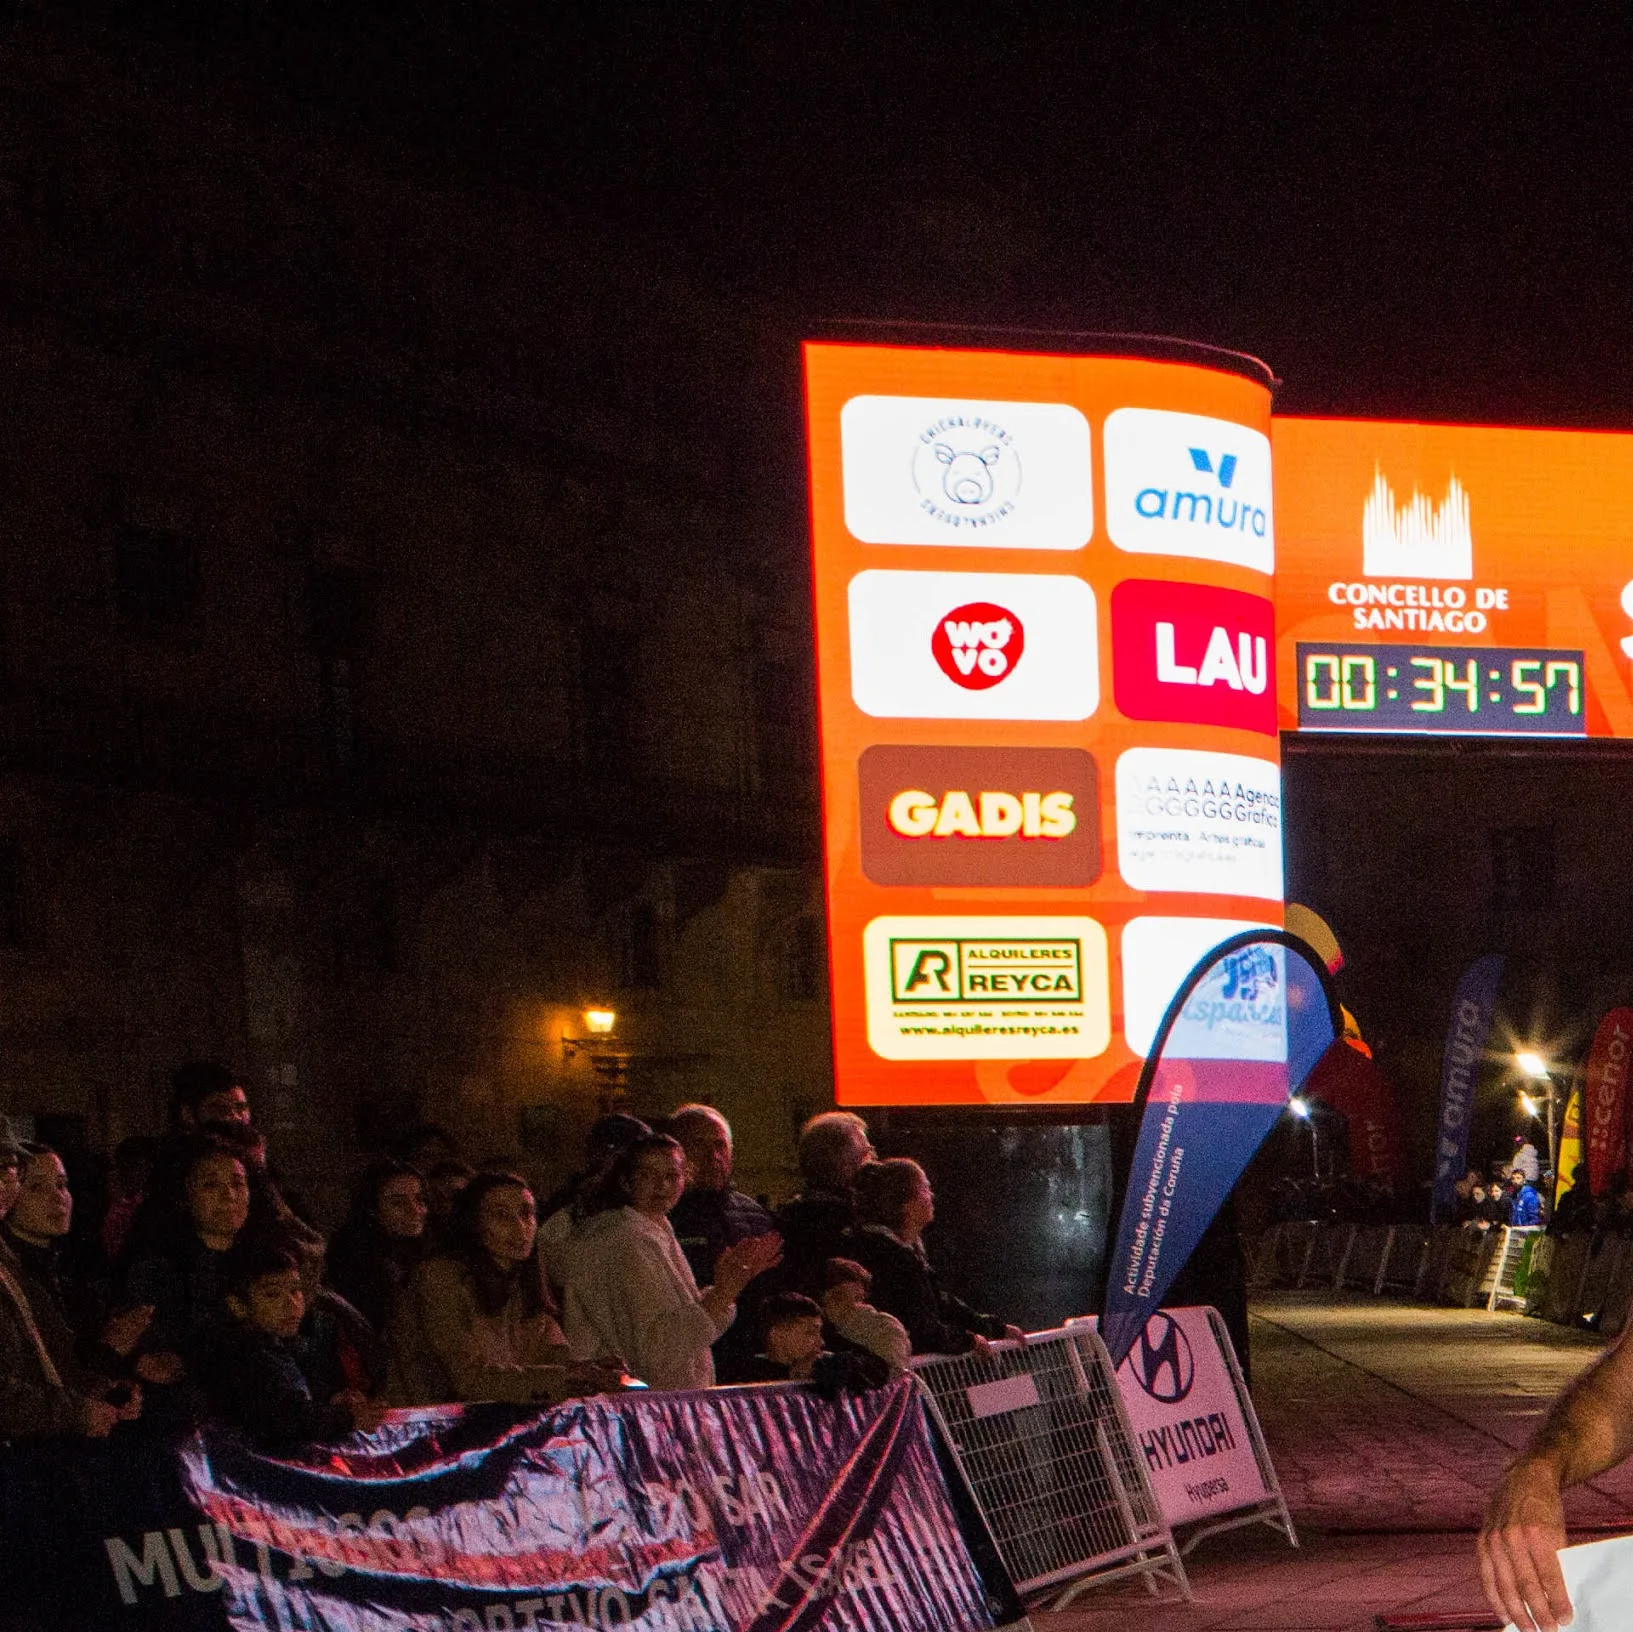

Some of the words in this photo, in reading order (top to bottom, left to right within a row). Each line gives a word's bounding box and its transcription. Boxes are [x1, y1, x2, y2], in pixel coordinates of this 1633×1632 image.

[1134, 487, 1266, 537] amura
[1329, 582, 1466, 610] CONCELLO
[1476, 589, 1508, 611] DE
[1354, 608, 1487, 634] SANTIAGO
[1156, 621, 1267, 695] LAU
[1306, 654, 1580, 714] 00:34:57
[888, 789, 1077, 838] GADIS
[968, 949, 1072, 959] ALQUILERES
[968, 974, 1074, 992] REYCA
[899, 1024, 1080, 1037] www.alquileresreyca.es
[1164, 1147, 1184, 1197] Coruña
[1124, 1221, 1149, 1295] Actividade
[1142, 1116, 1174, 1219] subvencionada
[1159, 1199, 1172, 1217] da
[1137, 1217, 1167, 1297] Deputación
[1139, 1412, 1237, 1472] HYUNDAI
